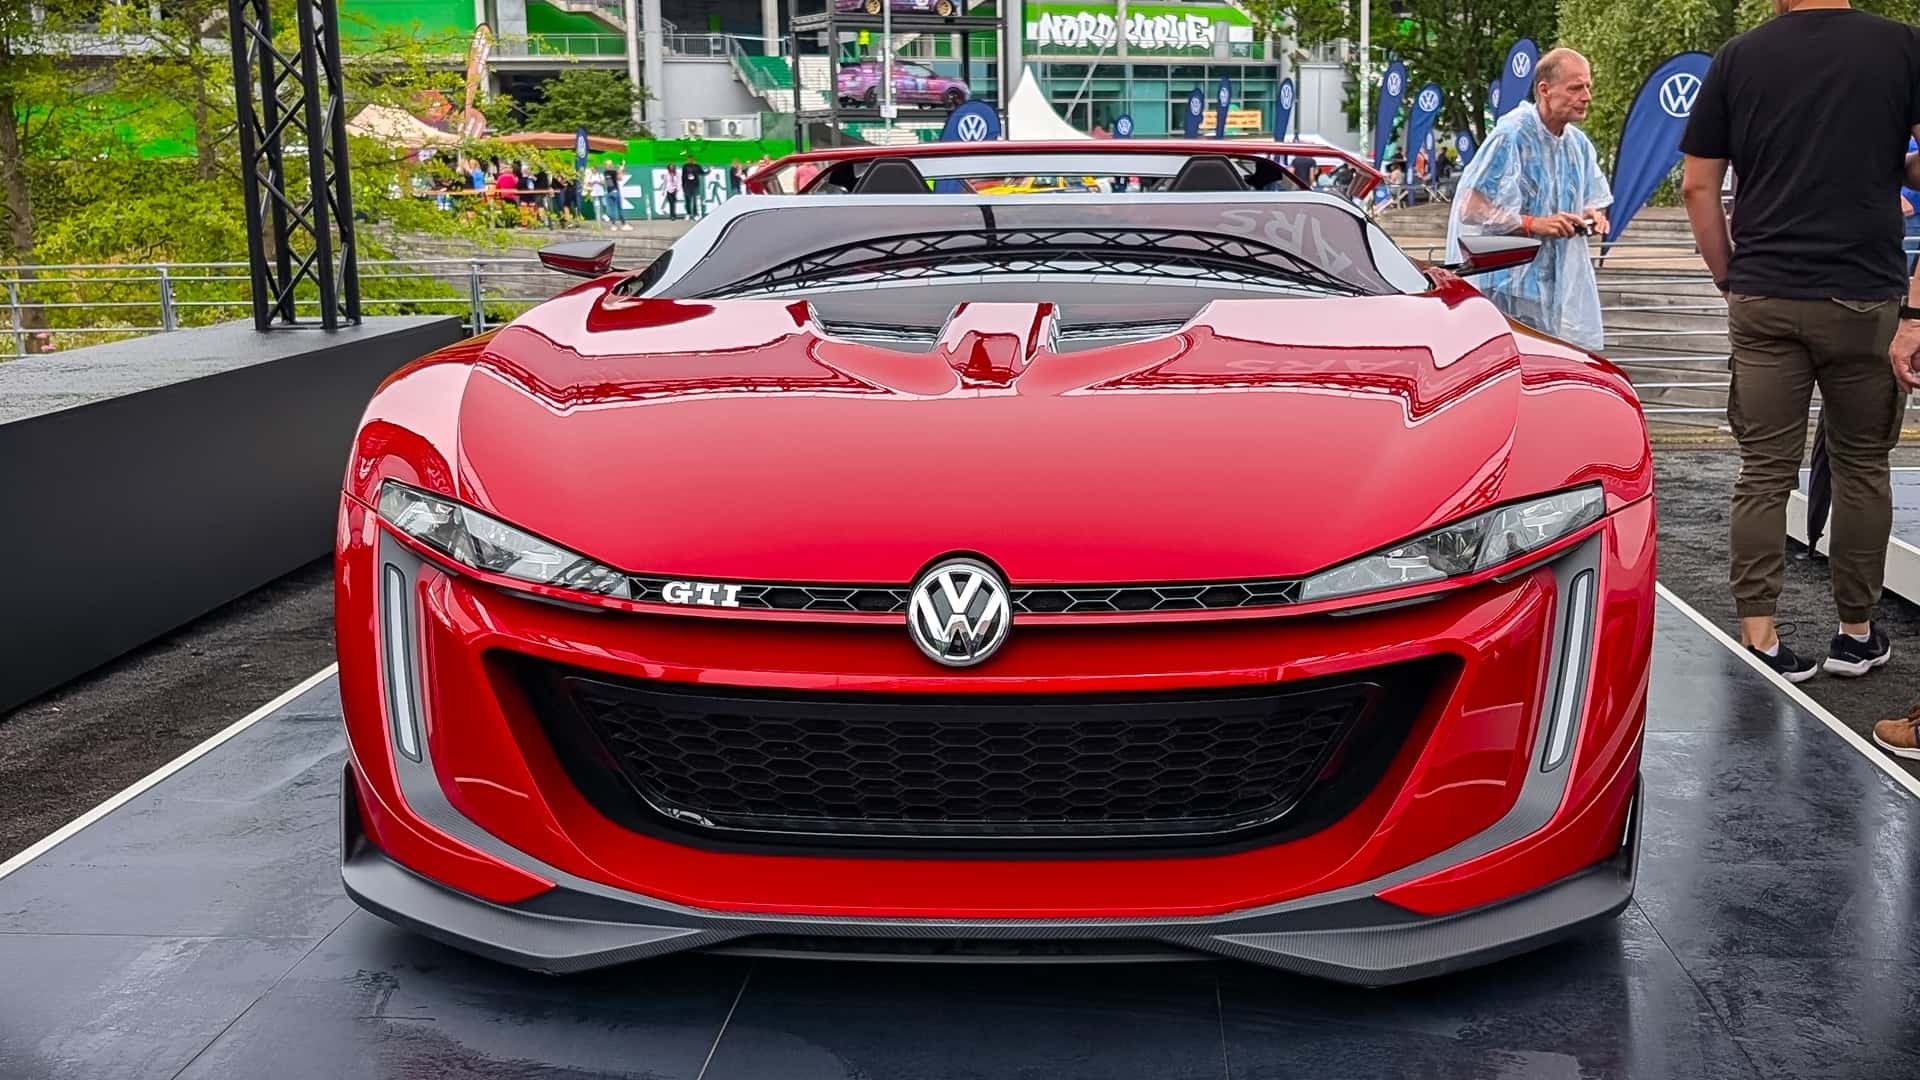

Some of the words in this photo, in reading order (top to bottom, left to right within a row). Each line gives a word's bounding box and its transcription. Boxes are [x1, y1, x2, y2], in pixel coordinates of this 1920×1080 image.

[1512, 52, 1531, 78] VW
[1418, 90, 1440, 112] VW
[1660, 73, 1702, 118] VW
[957, 114, 988, 142] VW
[662, 581, 742, 608] GTI
[910, 562, 1009, 663] VW
